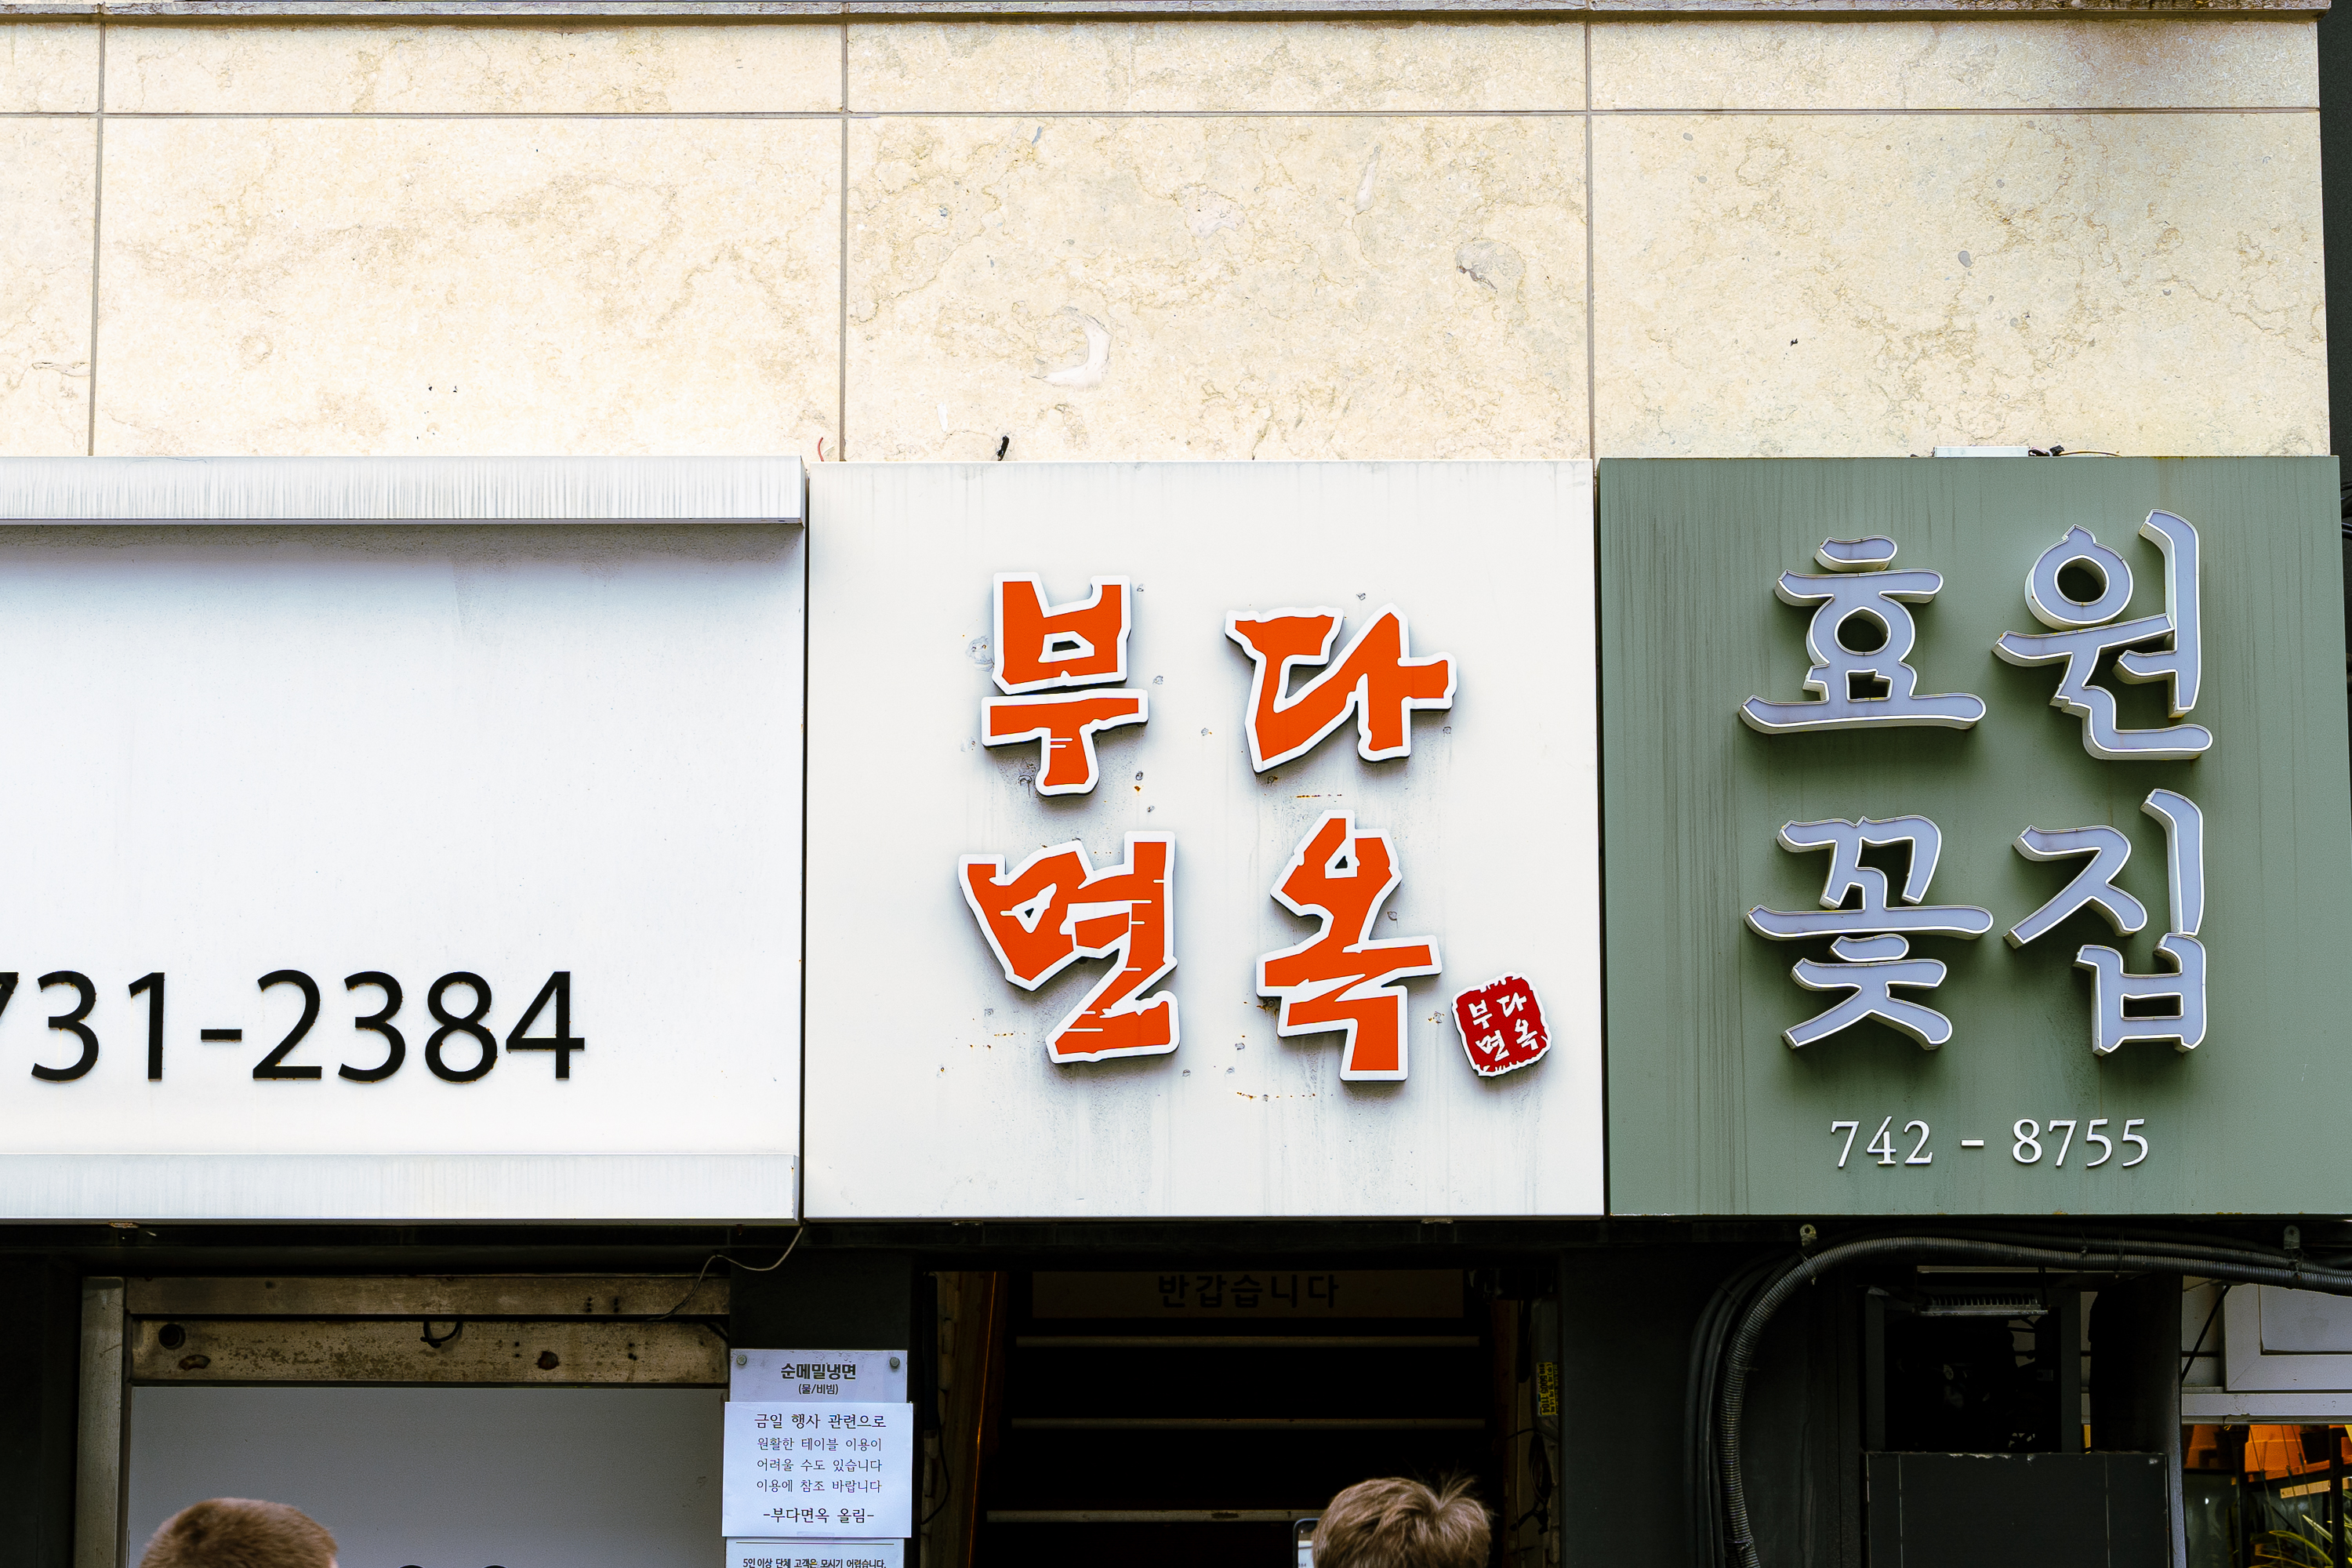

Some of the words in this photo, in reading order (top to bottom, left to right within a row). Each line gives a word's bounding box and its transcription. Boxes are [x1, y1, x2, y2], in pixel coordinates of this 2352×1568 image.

[1739, 508, 2213, 760] 효원
[982, 572, 1457, 797] 부다
[1744, 788, 2208, 1055] 꽃집
[959, 809, 1442, 1081] 면옥
[0, 970, 585, 1083] 31-2384
[1468, 992, 1527, 1029] 부다
[1475, 1018, 1539, 1062] 면옥
[1831, 1116, 1933, 1168] 742
[2012, 1118, 2149, 1167] 8755
[1159, 1274, 1339, 1308] 반갑습니다
[781, 1363, 856, 1380] 순메밀냉면
[798, 1384, 839, 1395] (물/비빔)
[754, 1414, 782, 1428] 금일
[791, 1414, 821, 1429] 행사
[828, 1414, 887, 1429] 관련으로
[757, 1437, 795, 1450] 원활한
[801, 1437, 839, 1451] 테이블
[845, 1438, 882, 1452] 이용이
[757, 1458, 794, 1472] 어려울
[800, 1459, 826, 1472] 수도
[833, 1459, 883, 1472] 있습니다
[757, 1479, 793, 1493] 이용에
[800, 1479, 826, 1493] 참조
[832, 1479, 883, 1494] 바랍니다
[763, 1508, 830, 1523] -부다면옥
[837, 1508, 874, 1523] 올림-
[775, 1558, 791, 1568] 단체
[820, 1559, 844, 1568] 모시기
